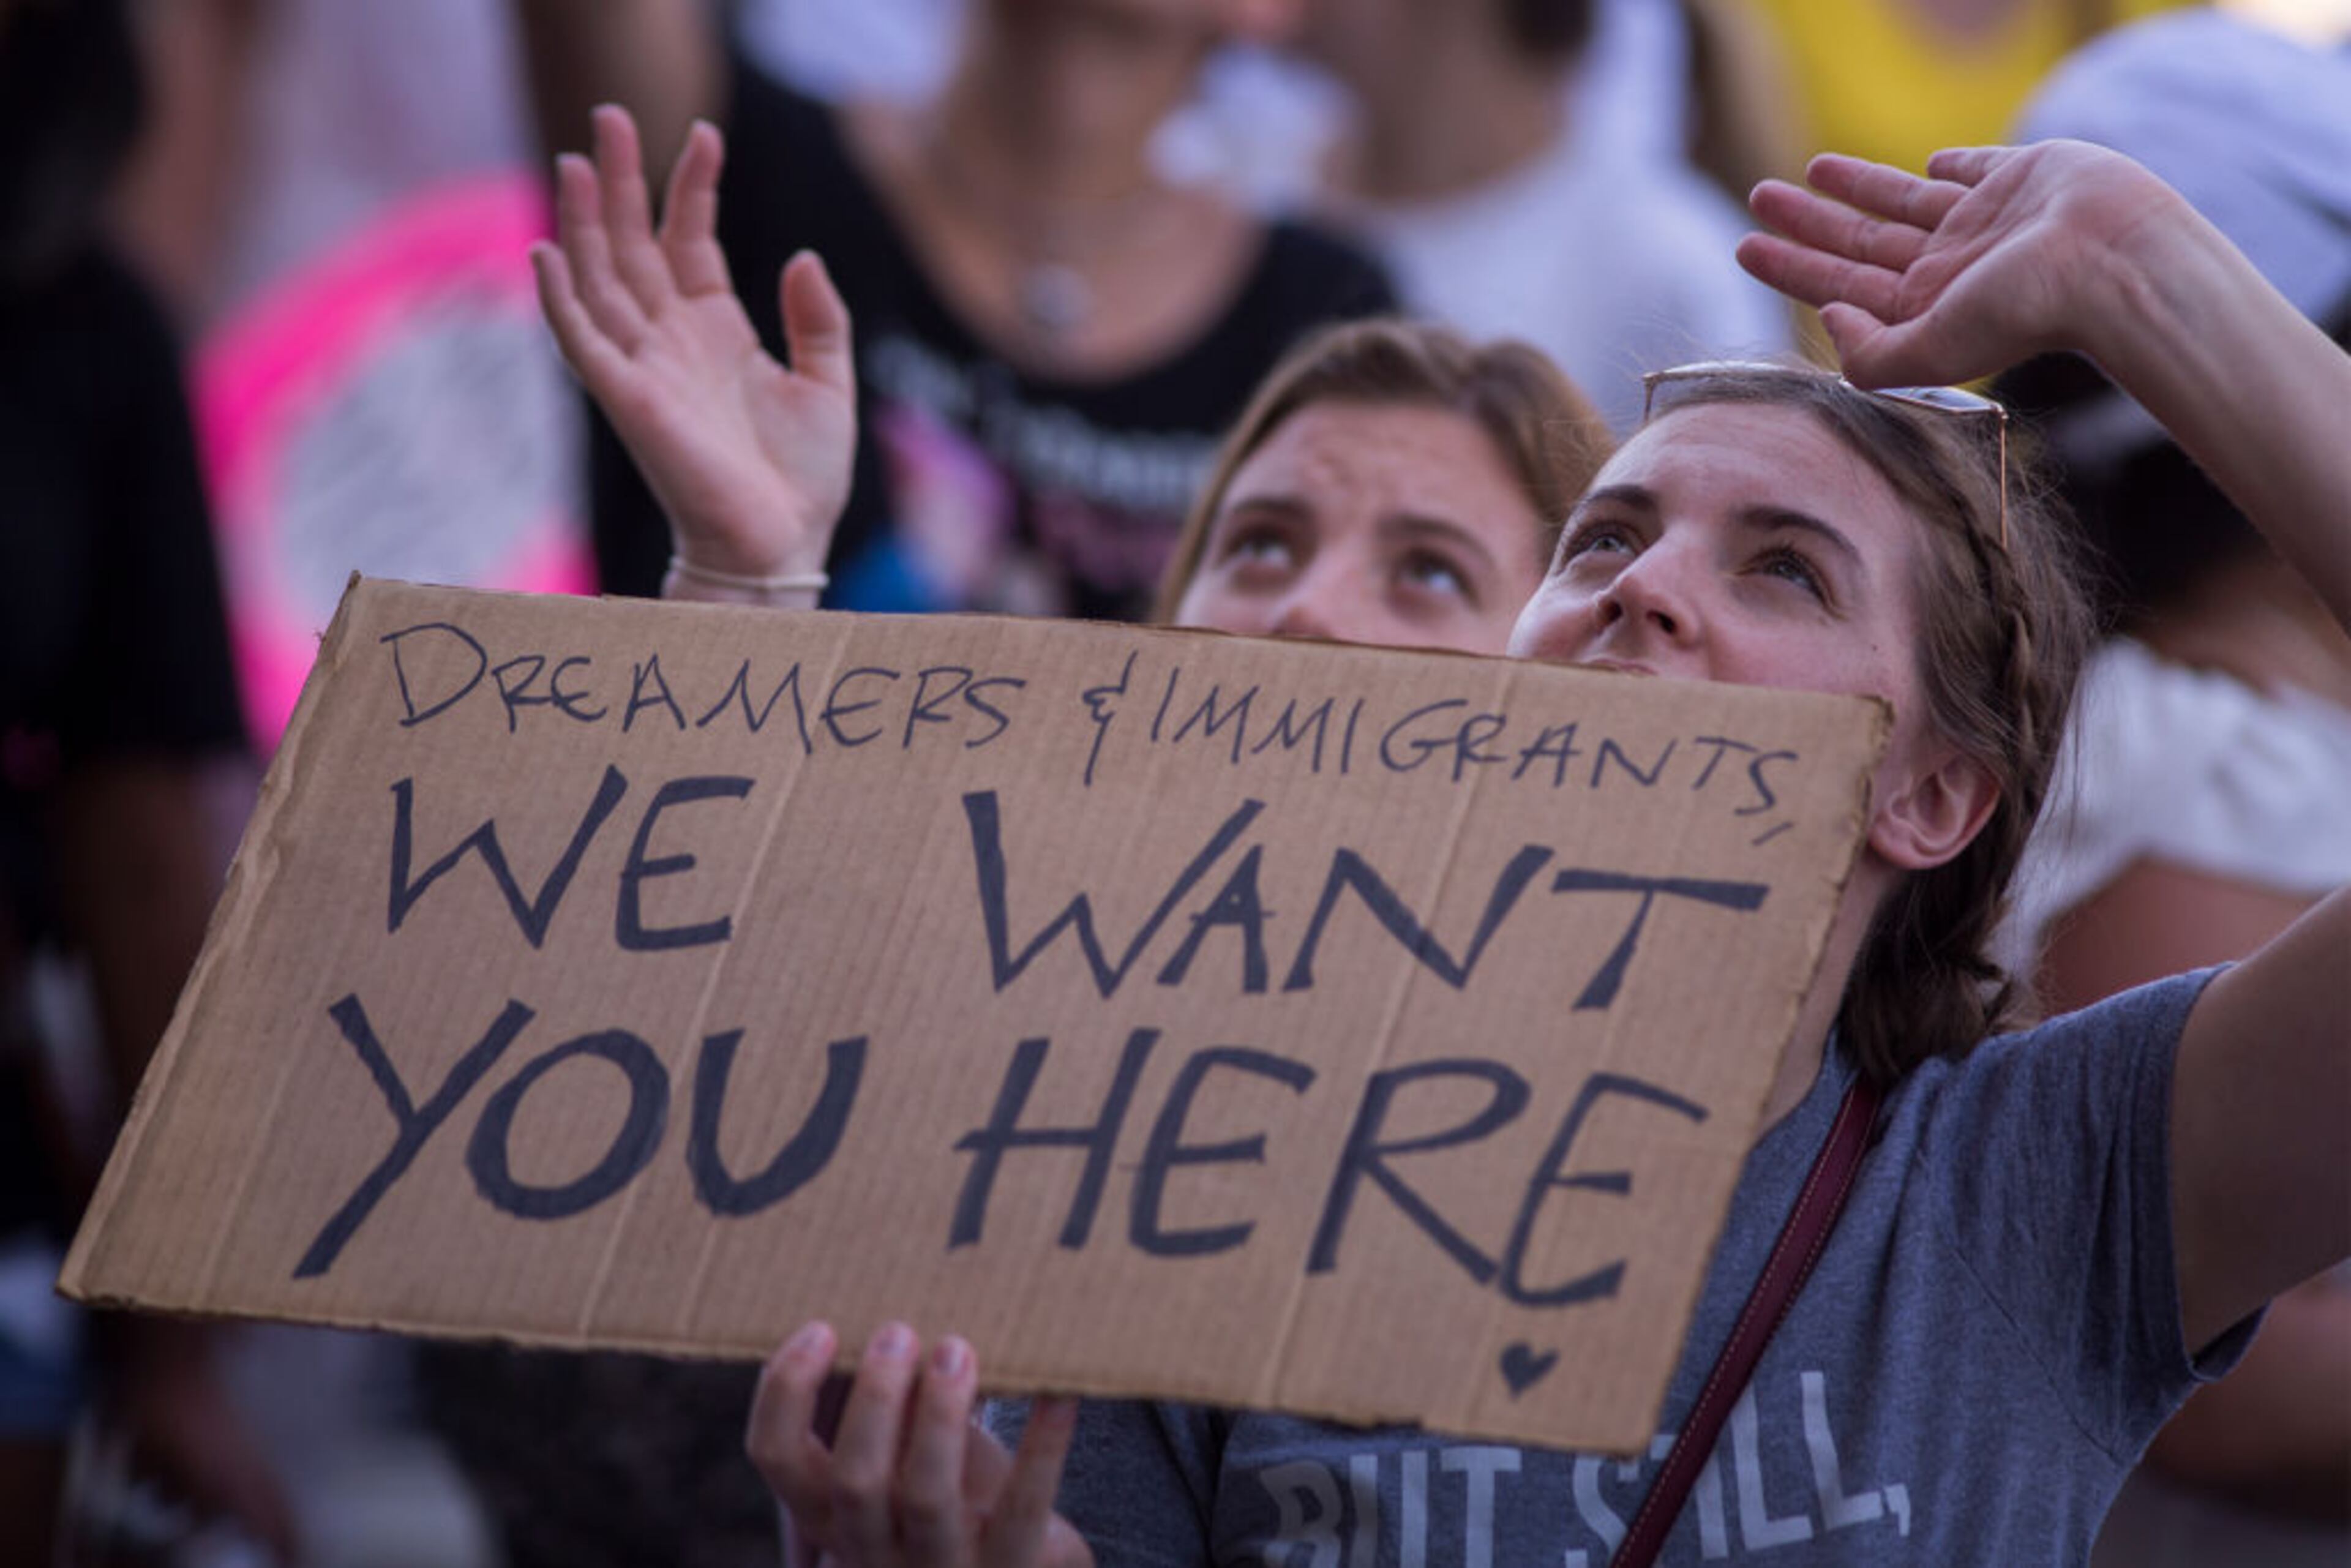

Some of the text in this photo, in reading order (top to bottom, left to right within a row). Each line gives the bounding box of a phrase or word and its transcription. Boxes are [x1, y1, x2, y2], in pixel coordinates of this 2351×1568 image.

[380, 623, 1798, 845] DREAMERS & IMMIGRANTS,
[388, 763, 1770, 1011] WE WANT
[291, 992, 1710, 1307] YOU HERE
[1259, 1446, 1521, 1568] BUT
